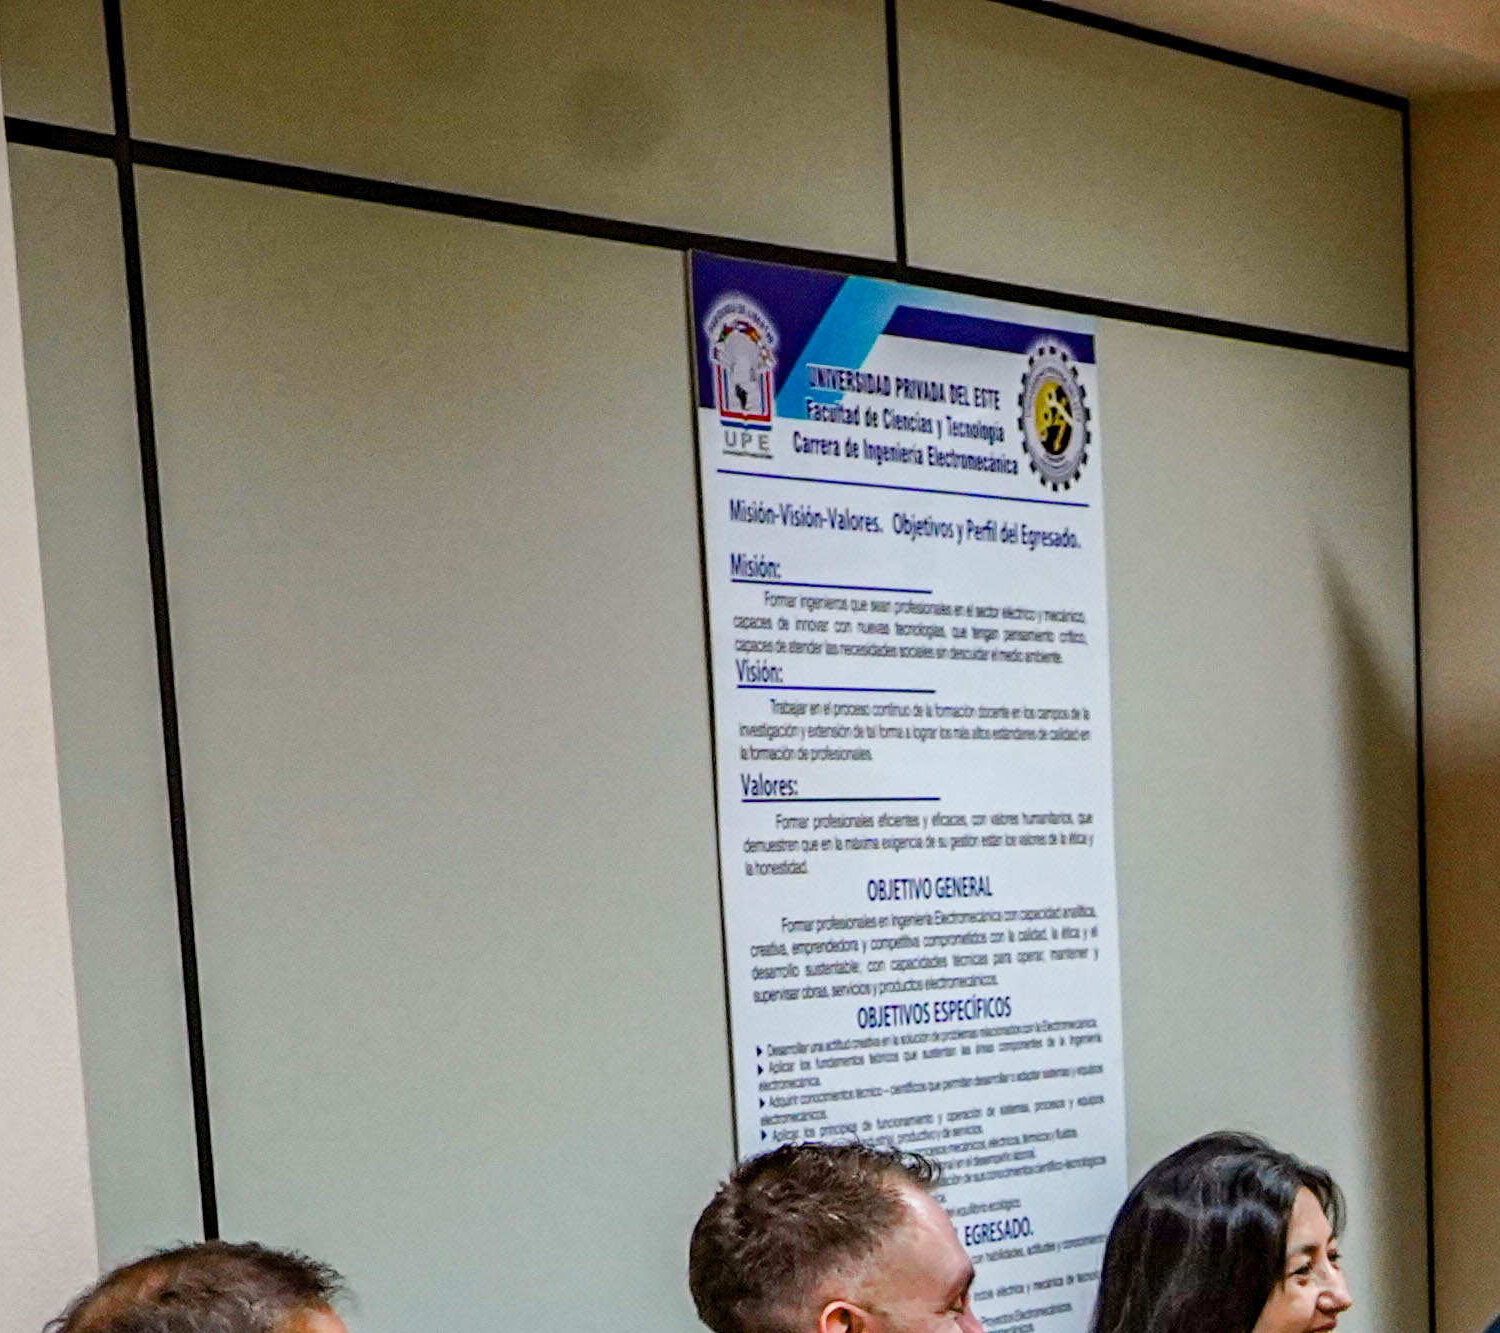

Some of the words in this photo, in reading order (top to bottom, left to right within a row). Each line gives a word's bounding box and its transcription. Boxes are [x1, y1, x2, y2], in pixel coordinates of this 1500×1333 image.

[806, 366, 892, 397] UNIVERSIDAD
[895, 377, 947, 404] PRIVADA
[949, 383, 972, 407] DEL
[806, 398, 861, 427] Facultad
[864, 405, 879, 428] de
[882, 407, 933, 434] Ciencias
[723, 432, 771, 452] UPE
[792, 430, 841, 457] Carrera
[844, 437, 860, 459] de
[892, 512, 954, 542] Objetivos
[955, 523, 964, 545] y
[966, 519, 997, 542] Perfil
[1000, 521, 1019, 544] del
[1020, 523, 1082, 551] Egresado.
[730, 551, 782, 579] Misión:
[735, 658, 784, 683] Visión:
[740, 772, 799, 797] Valores:
[866, 877, 933, 902] OBJETIVO
[934, 875, 994, 899] GENERAL
[857, 1001, 931, 1029] OBJETIVOS
[933, 994, 1013, 1023] ESPECÍFICOS
[964, 1216, 1034, 1246] EGRESADO.
